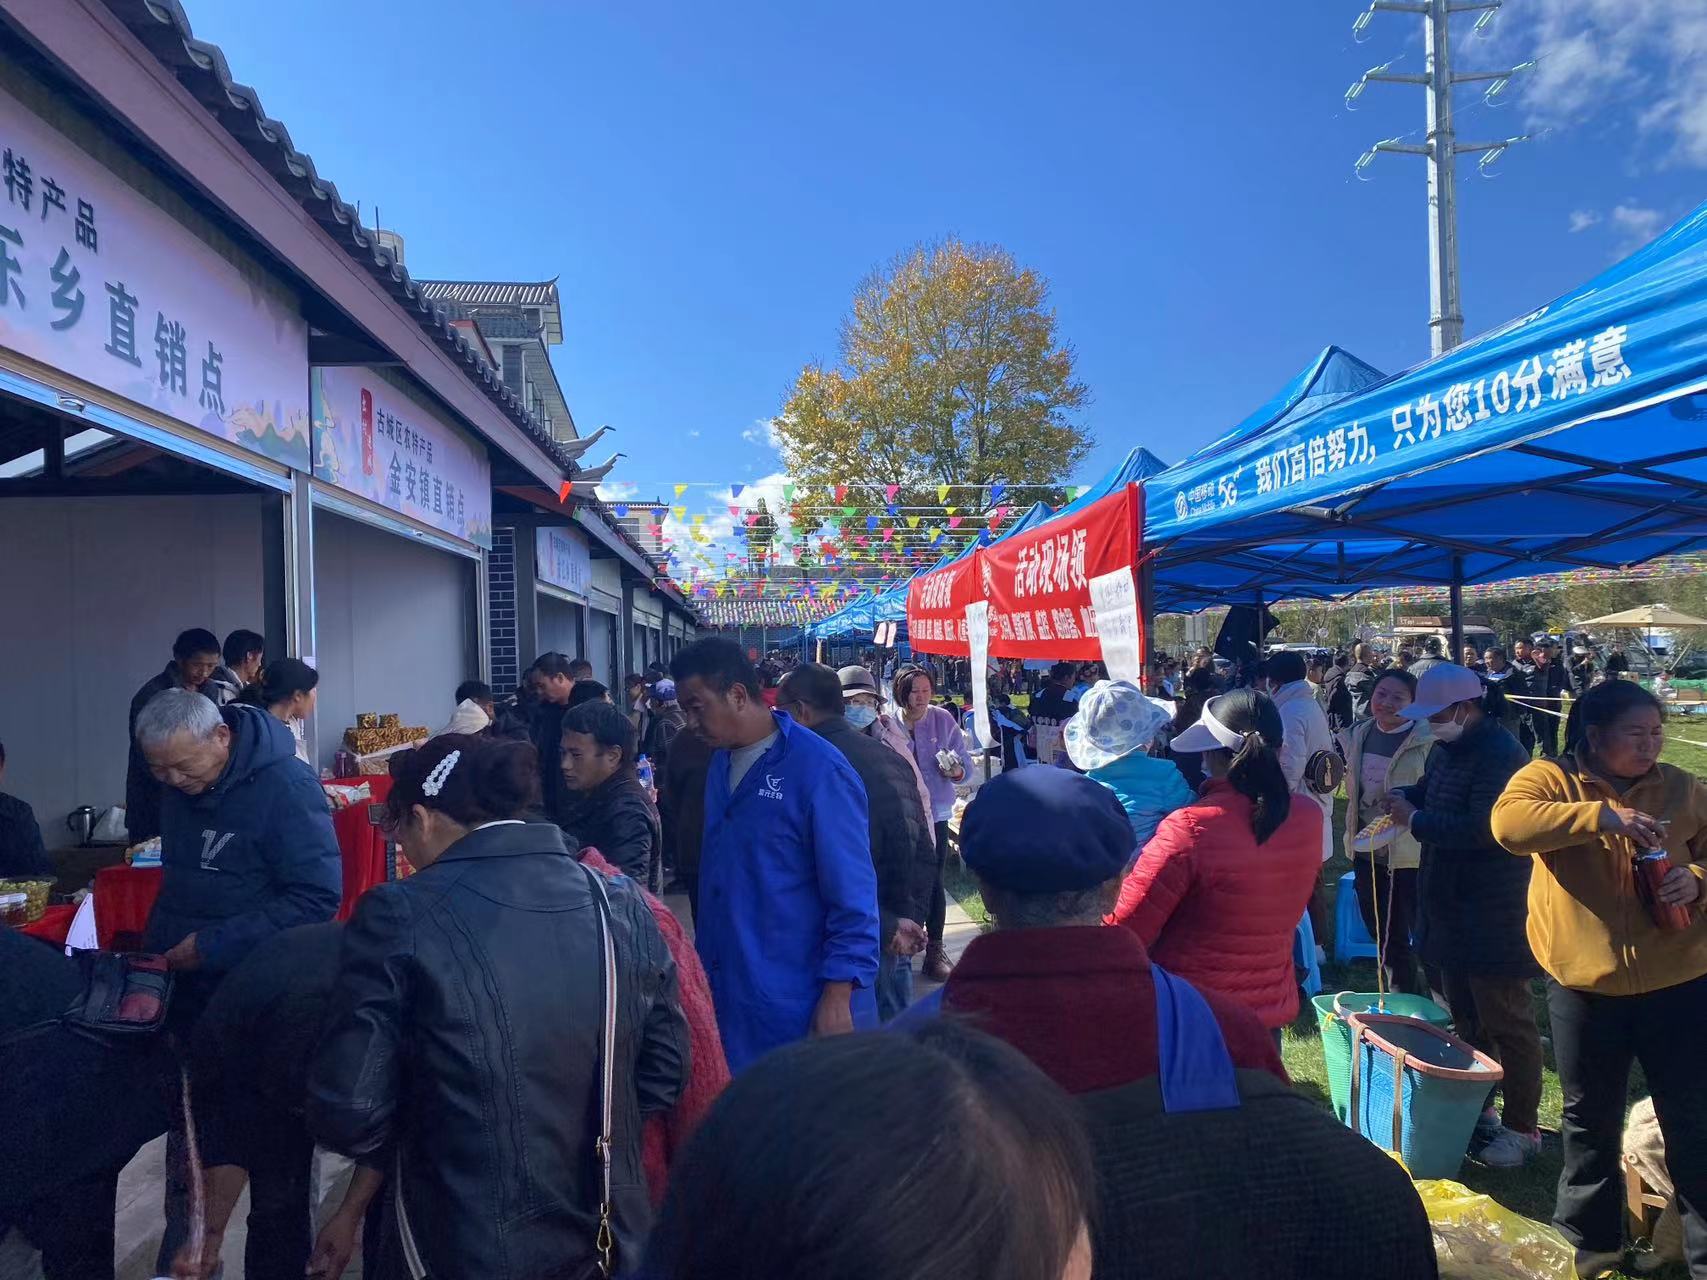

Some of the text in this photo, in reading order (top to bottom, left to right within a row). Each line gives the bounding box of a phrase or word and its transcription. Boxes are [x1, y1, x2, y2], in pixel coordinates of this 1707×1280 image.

[376, 407, 433, 464] 古城区农特产品
[389, 451, 464, 528] 金安镇直销点
